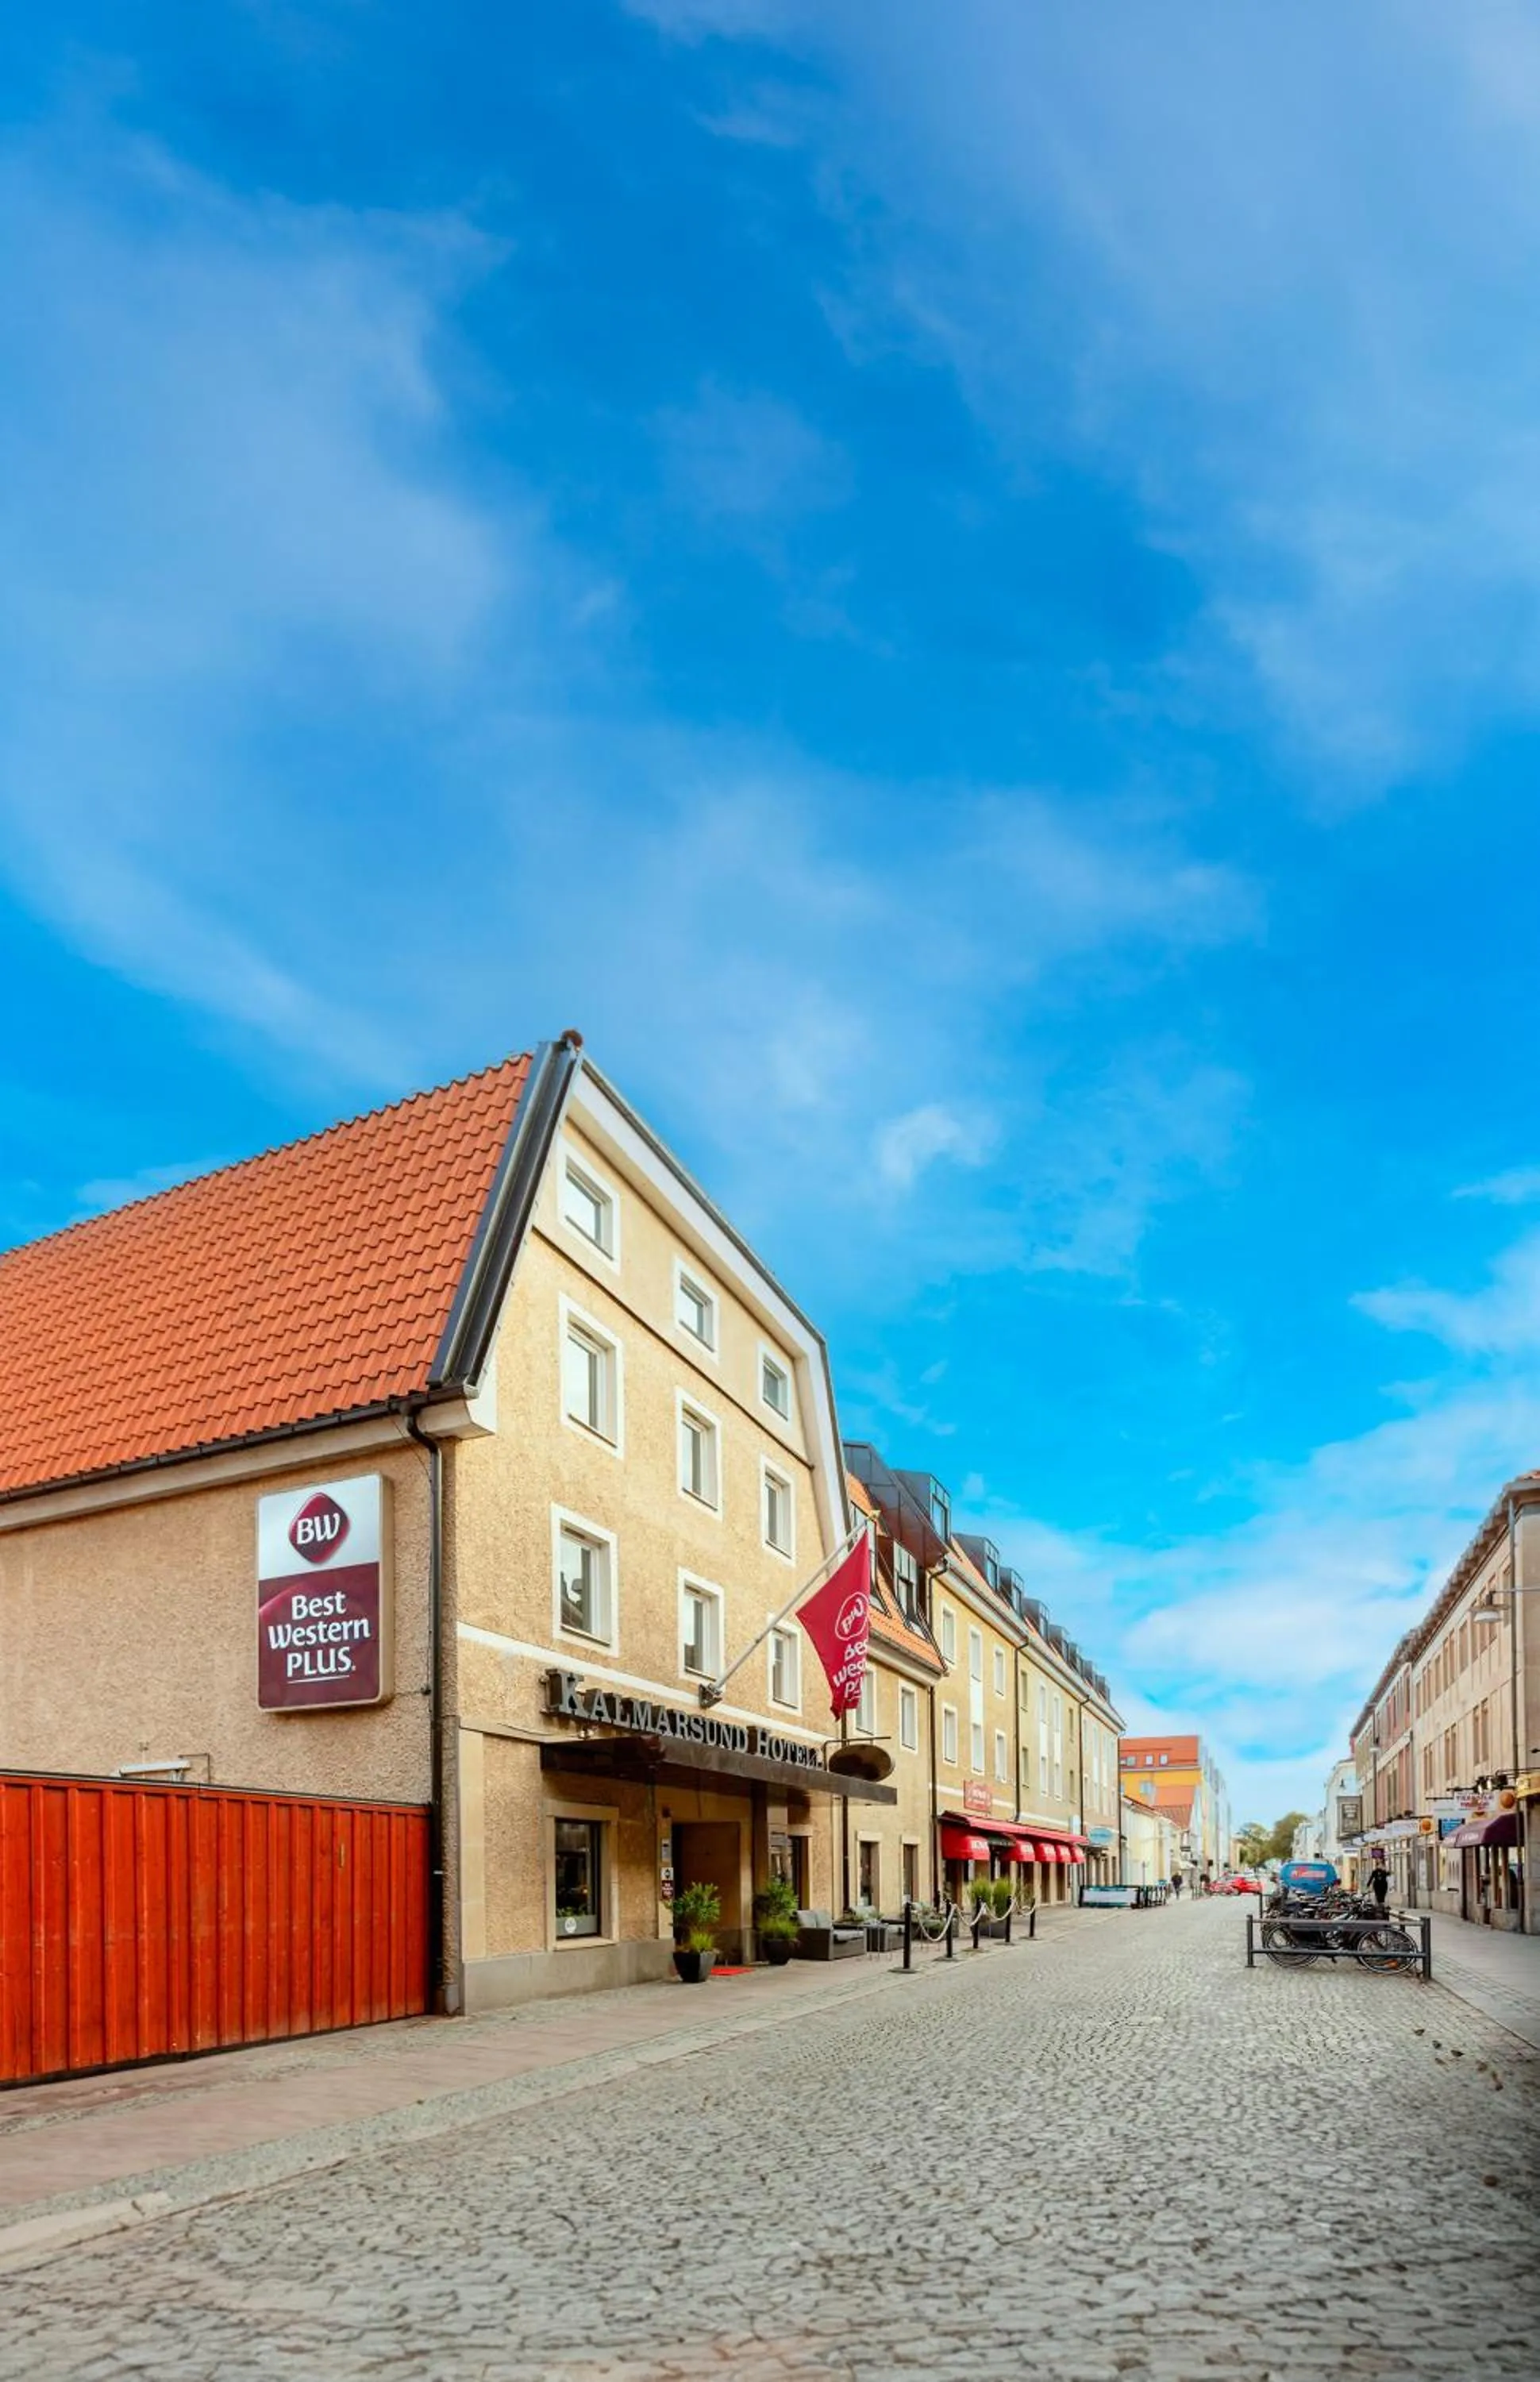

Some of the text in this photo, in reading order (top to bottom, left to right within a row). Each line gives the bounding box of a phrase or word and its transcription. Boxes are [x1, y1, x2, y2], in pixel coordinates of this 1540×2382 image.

[295, 1512, 341, 1545] BW
[291, 1591, 346, 1621] Best
[268, 1617, 371, 1649] Western
[554, 1670, 749, 1755] KALMARSUND
